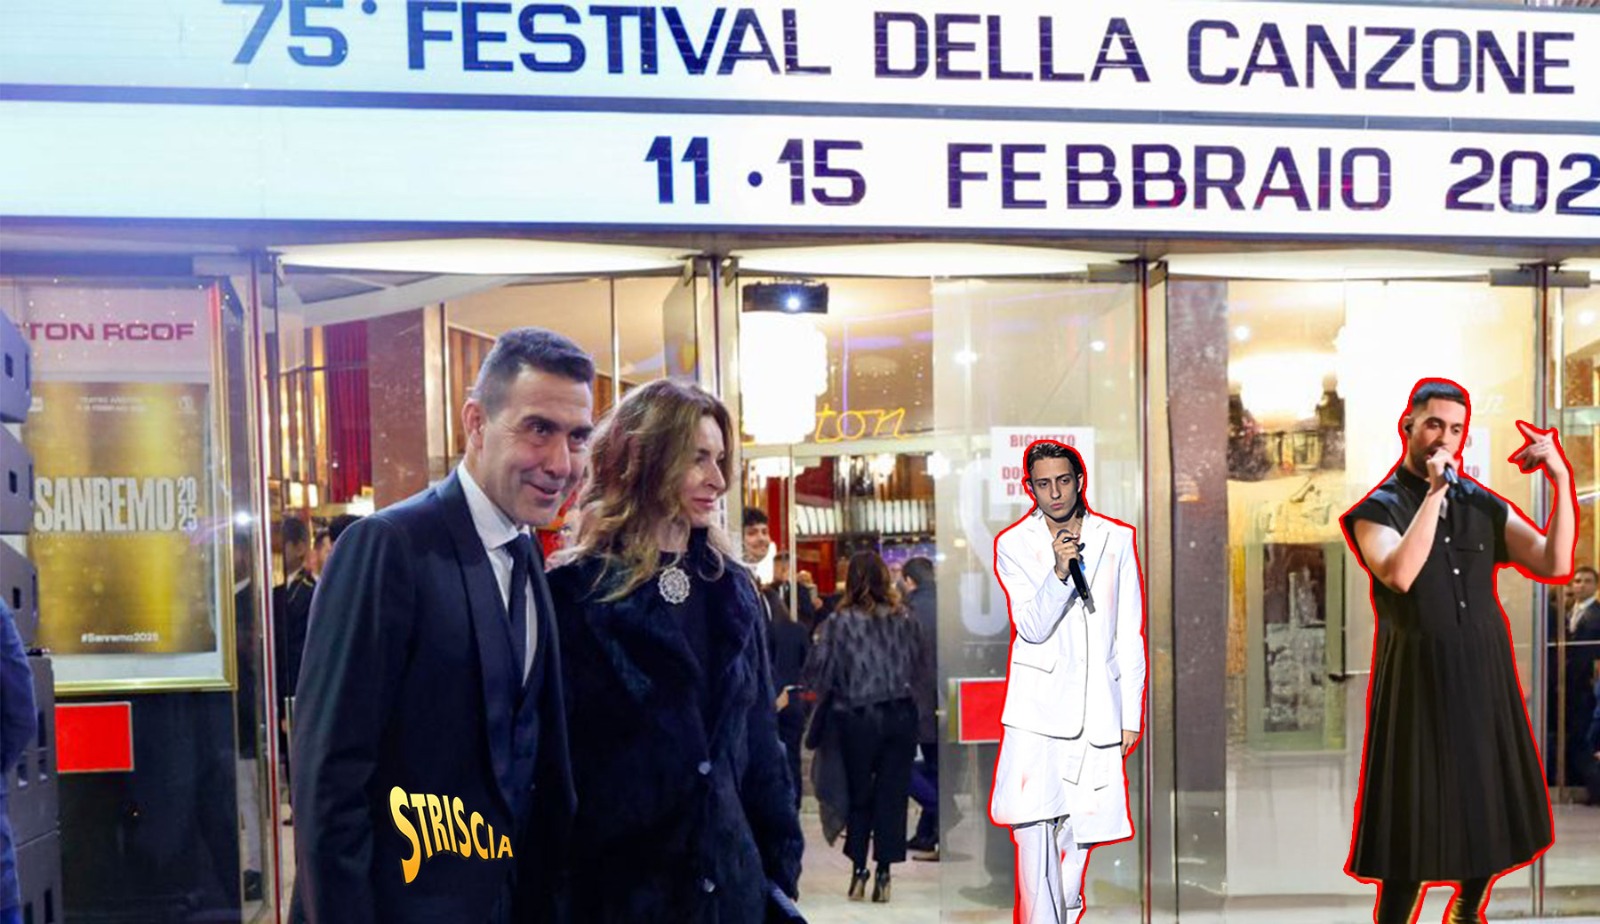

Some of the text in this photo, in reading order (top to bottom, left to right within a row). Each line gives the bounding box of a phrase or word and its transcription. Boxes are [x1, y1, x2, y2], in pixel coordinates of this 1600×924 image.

[407, 0, 831, 75] FESTIVAL
[874, 11, 1151, 83] DELLA
[1187, 19, 1576, 95] CANZONE
[644, 135, 710, 204] 11
[946, 142, 1391, 211] FEBBRAIO
[29, 324, 95, 341] TON
[34, 476, 176, 532] SANREMO
